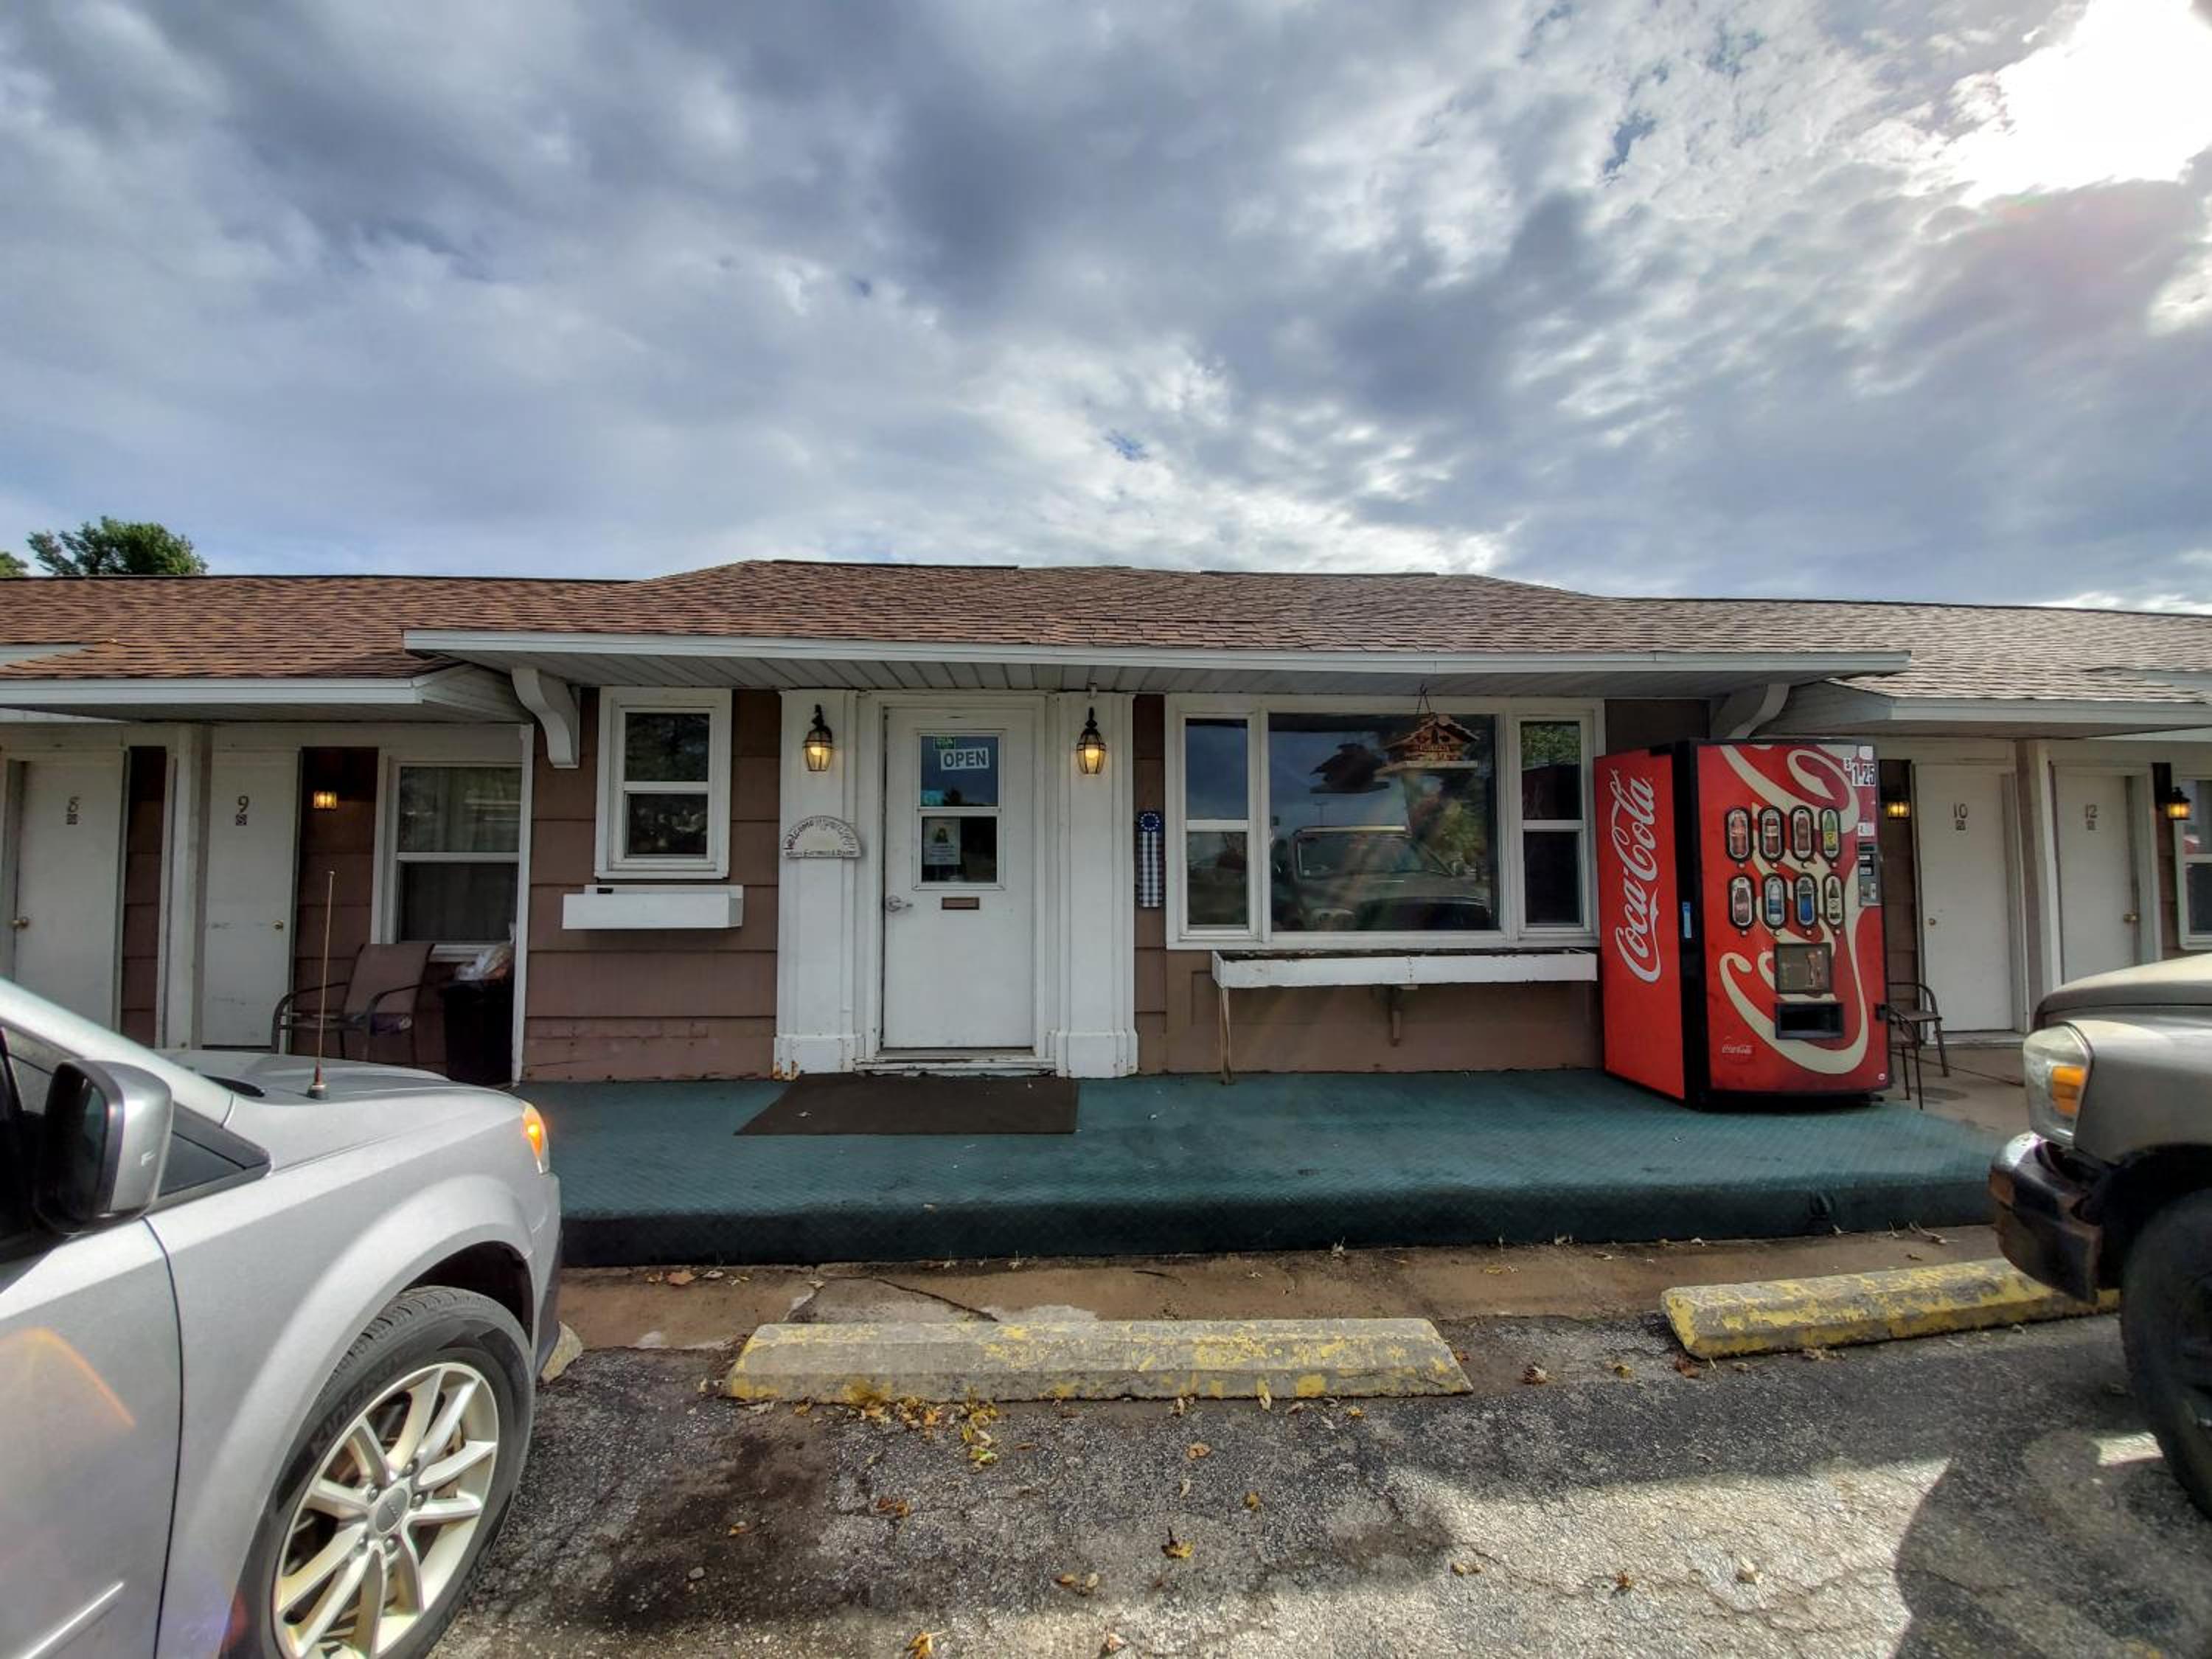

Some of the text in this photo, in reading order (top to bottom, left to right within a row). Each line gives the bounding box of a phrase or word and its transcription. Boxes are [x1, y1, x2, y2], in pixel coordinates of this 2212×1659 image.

[944, 750, 987, 768] OPEN
[238, 796, 249, 813] 9
[1953, 803, 1968, 818] 10
[2085, 804, 2098, 818] 12
[1610, 769, 1660, 982] Coca-Cola
